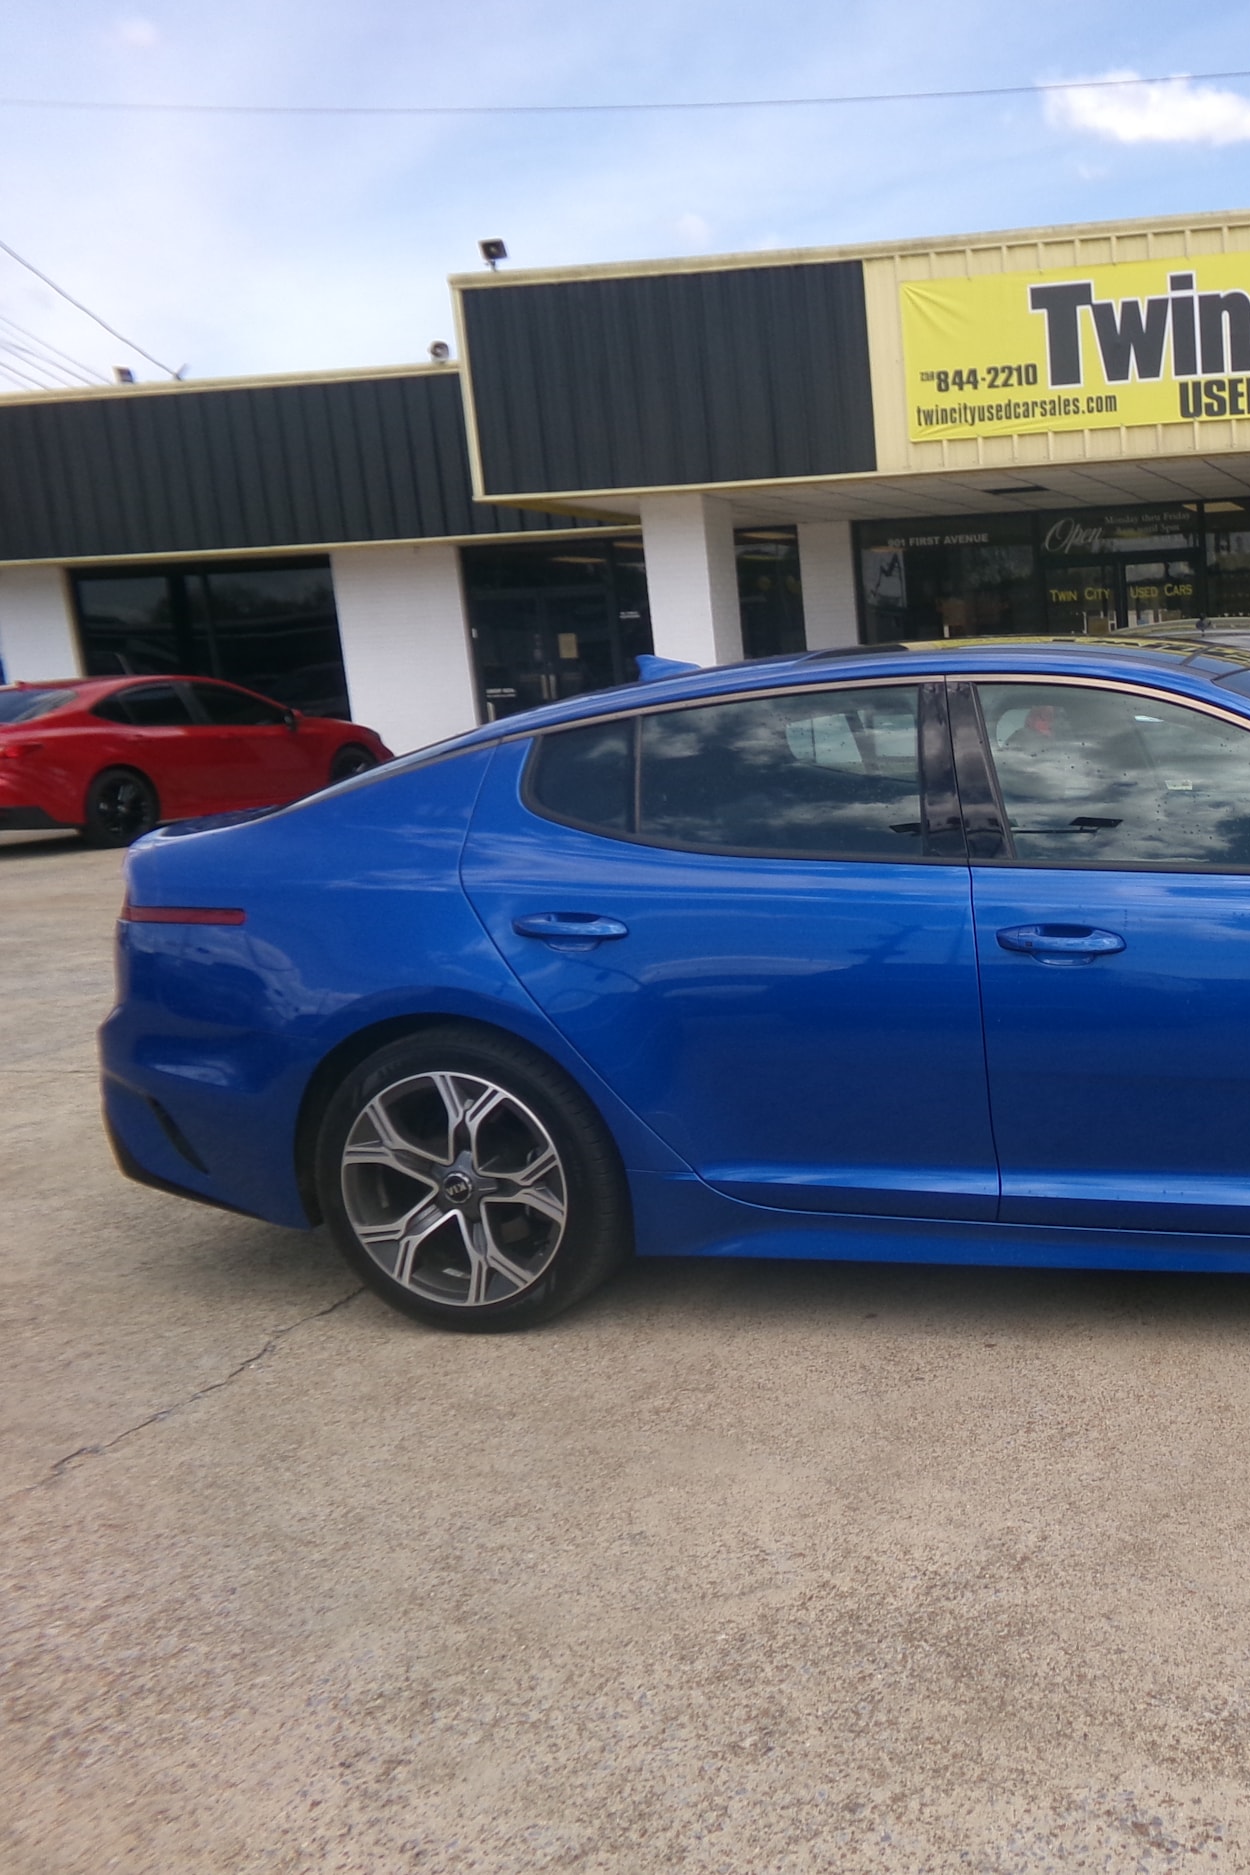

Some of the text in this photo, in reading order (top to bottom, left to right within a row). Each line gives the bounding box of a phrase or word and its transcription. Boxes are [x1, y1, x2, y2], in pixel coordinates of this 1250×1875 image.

[936, 363, 1038, 393] 844-2210
[917, 394, 1117, 427] twincityusedcarsales.com
[909, 536, 940, 547] FIRST
[943, 533, 989, 545] AVENUE
[1045, 517, 1103, 554] Open
[446, 1181, 468, 1196] KIA
